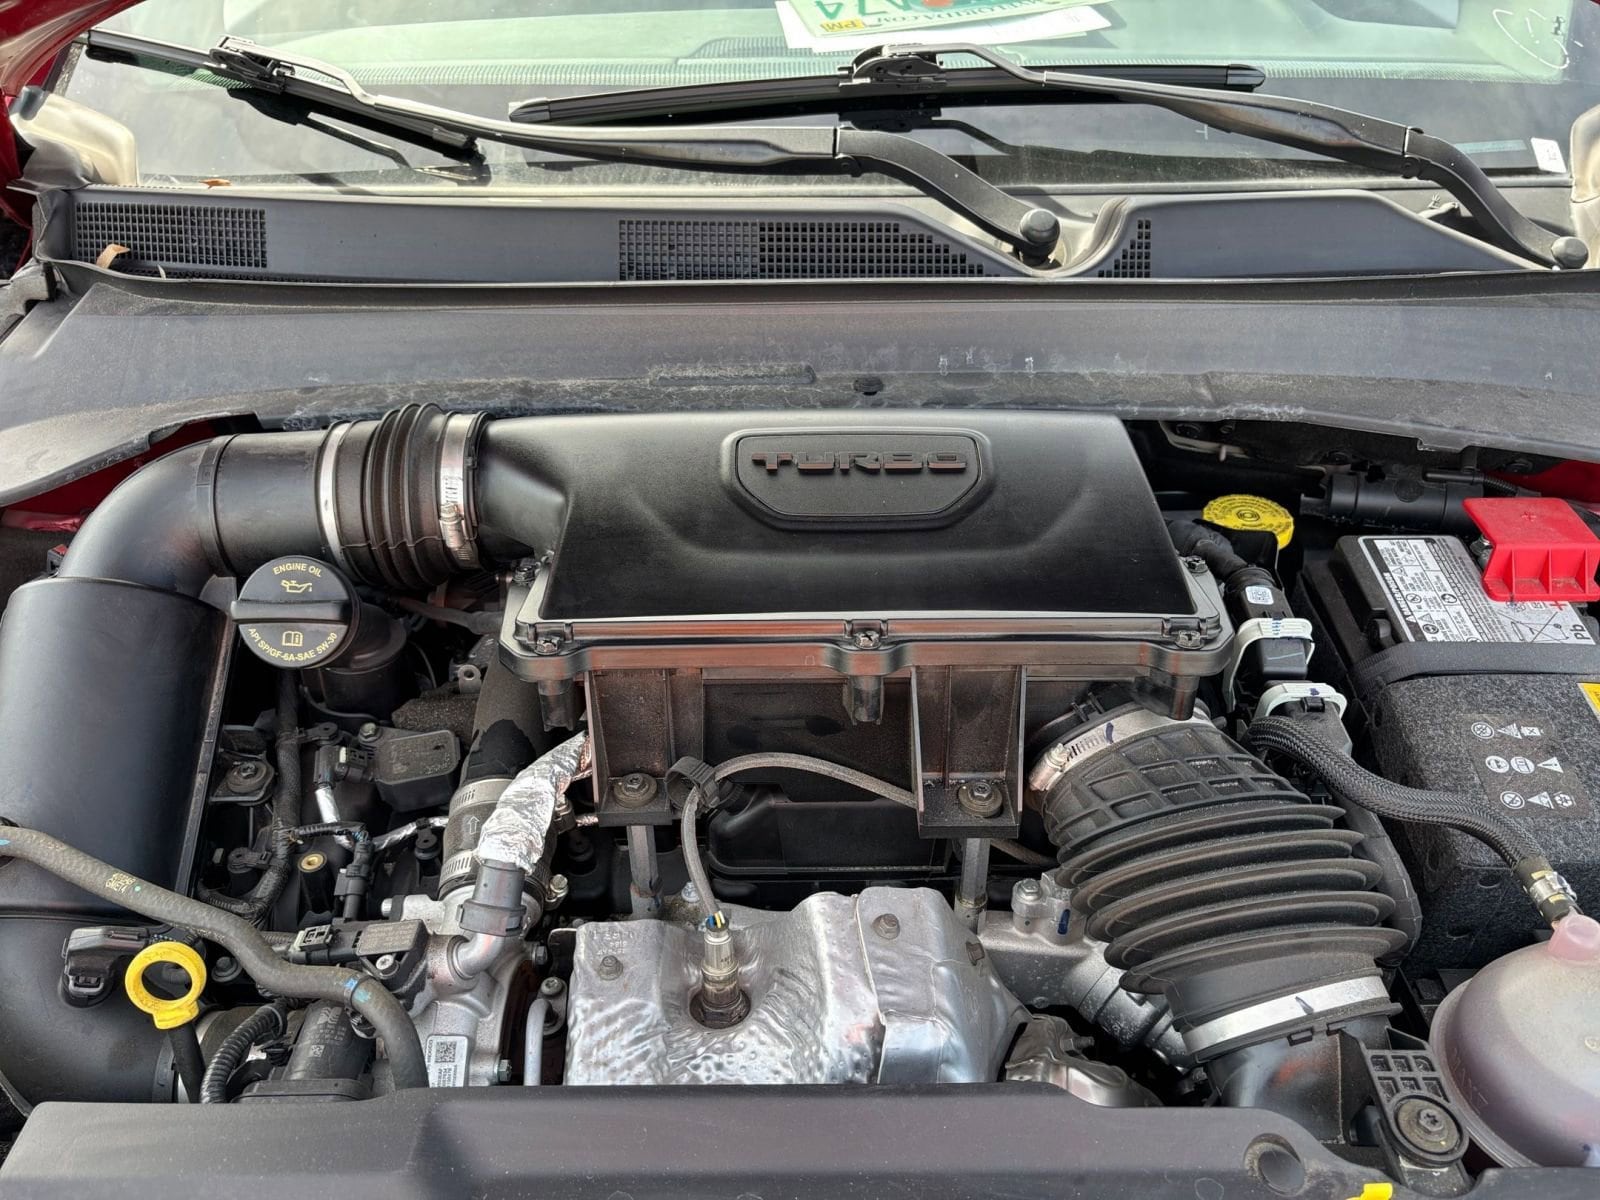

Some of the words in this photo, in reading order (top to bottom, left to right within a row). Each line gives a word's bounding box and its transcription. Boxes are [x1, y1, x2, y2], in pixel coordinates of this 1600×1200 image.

[752, 451, 967, 473] TURBO
[272, 563, 307, 575] ENGINE
[308, 564, 323, 578] OIL
[248, 627, 261, 643] API
[316, 632, 338, 654] 5W-30
